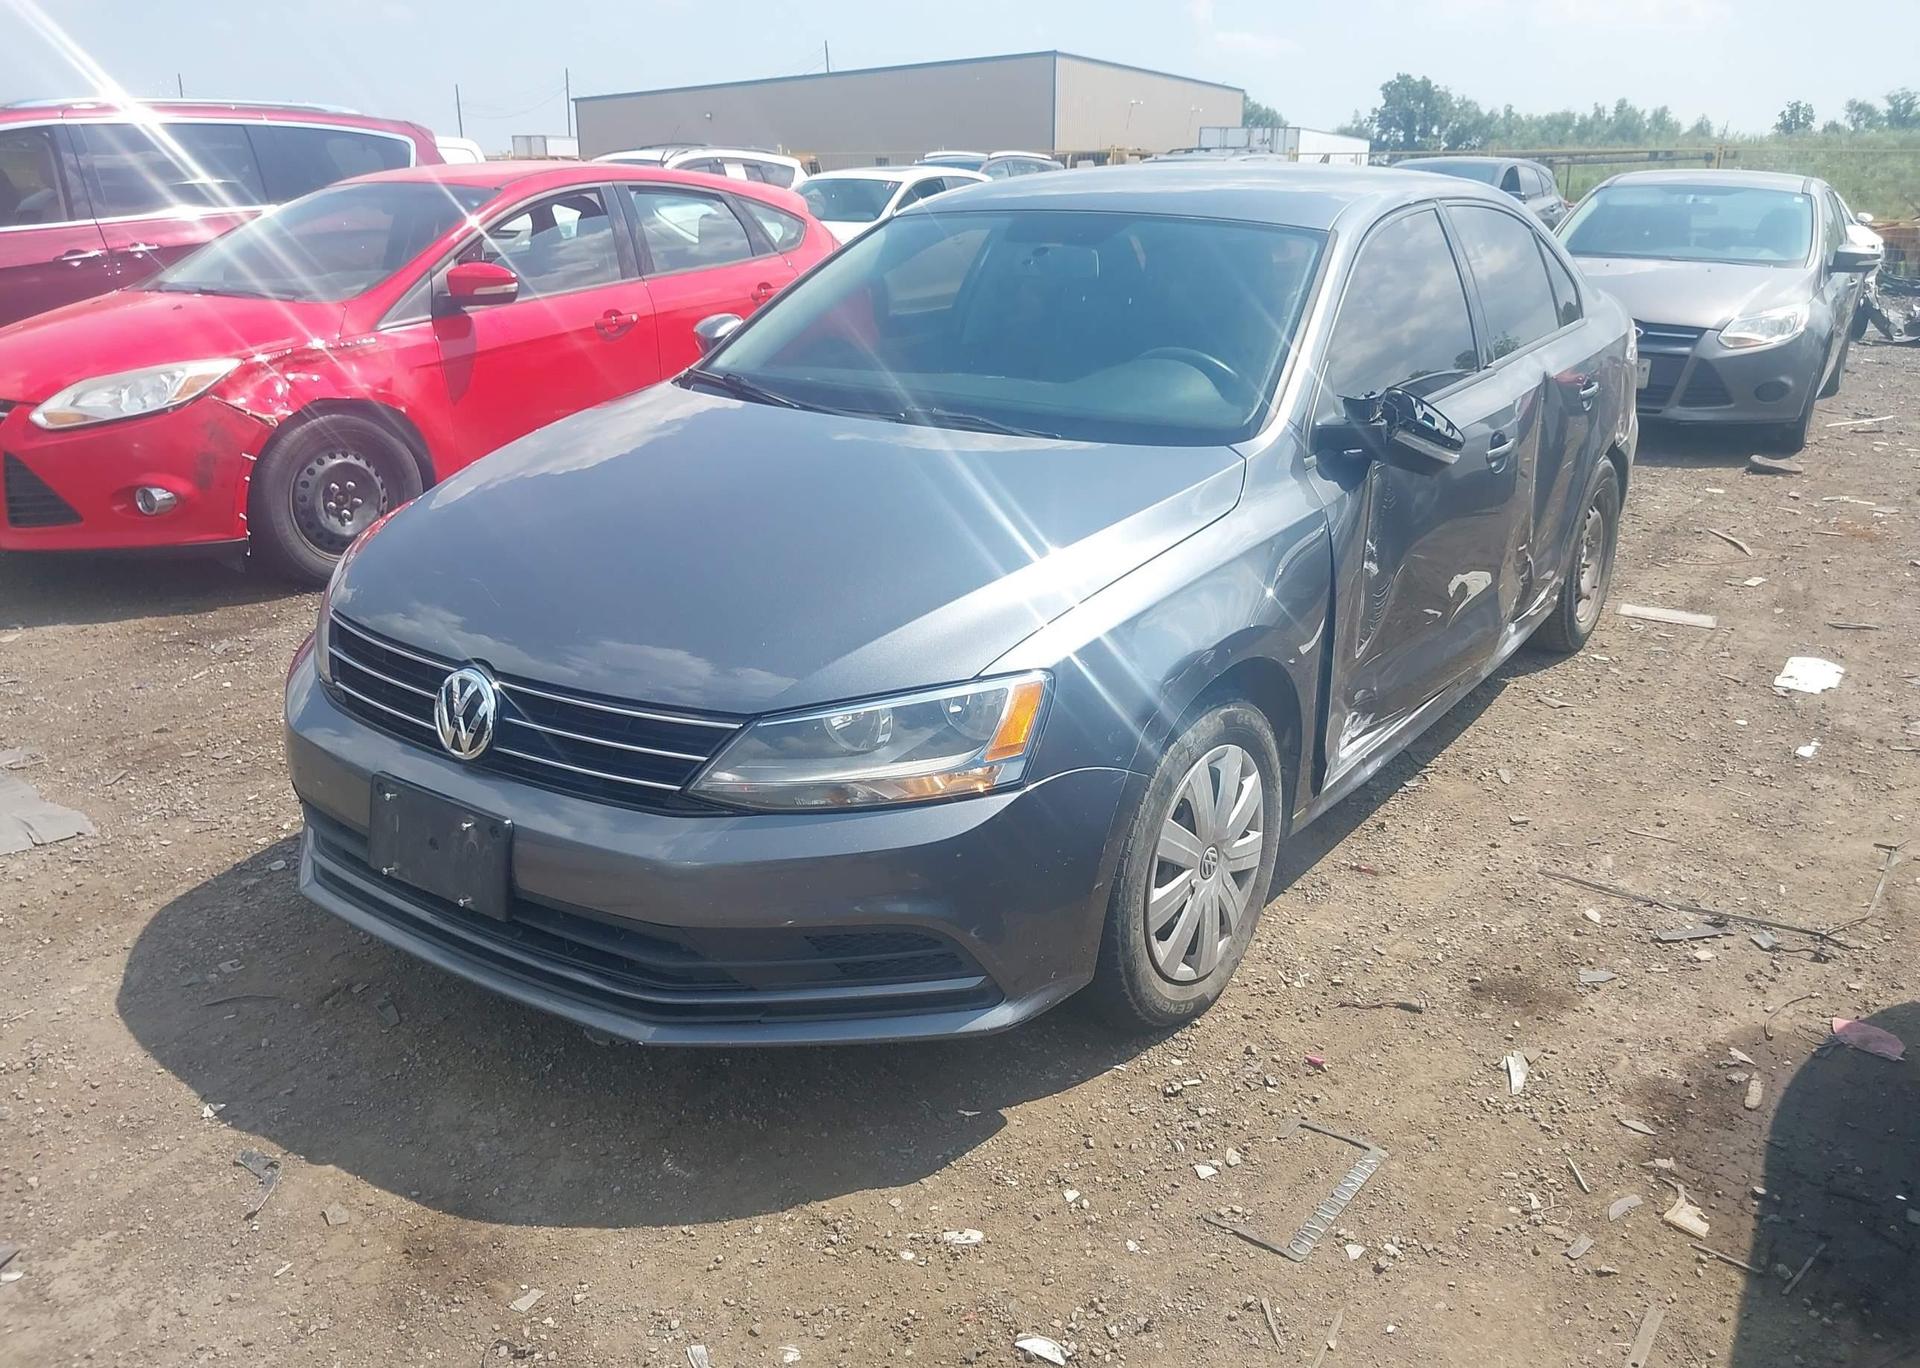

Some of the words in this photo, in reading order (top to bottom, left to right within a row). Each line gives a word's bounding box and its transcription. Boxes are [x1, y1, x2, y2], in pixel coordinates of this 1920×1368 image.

[435, 667, 496, 760] VW
[1315, 1188, 1353, 1226] AUTO
[1339, 1157, 1379, 1192] SALES
